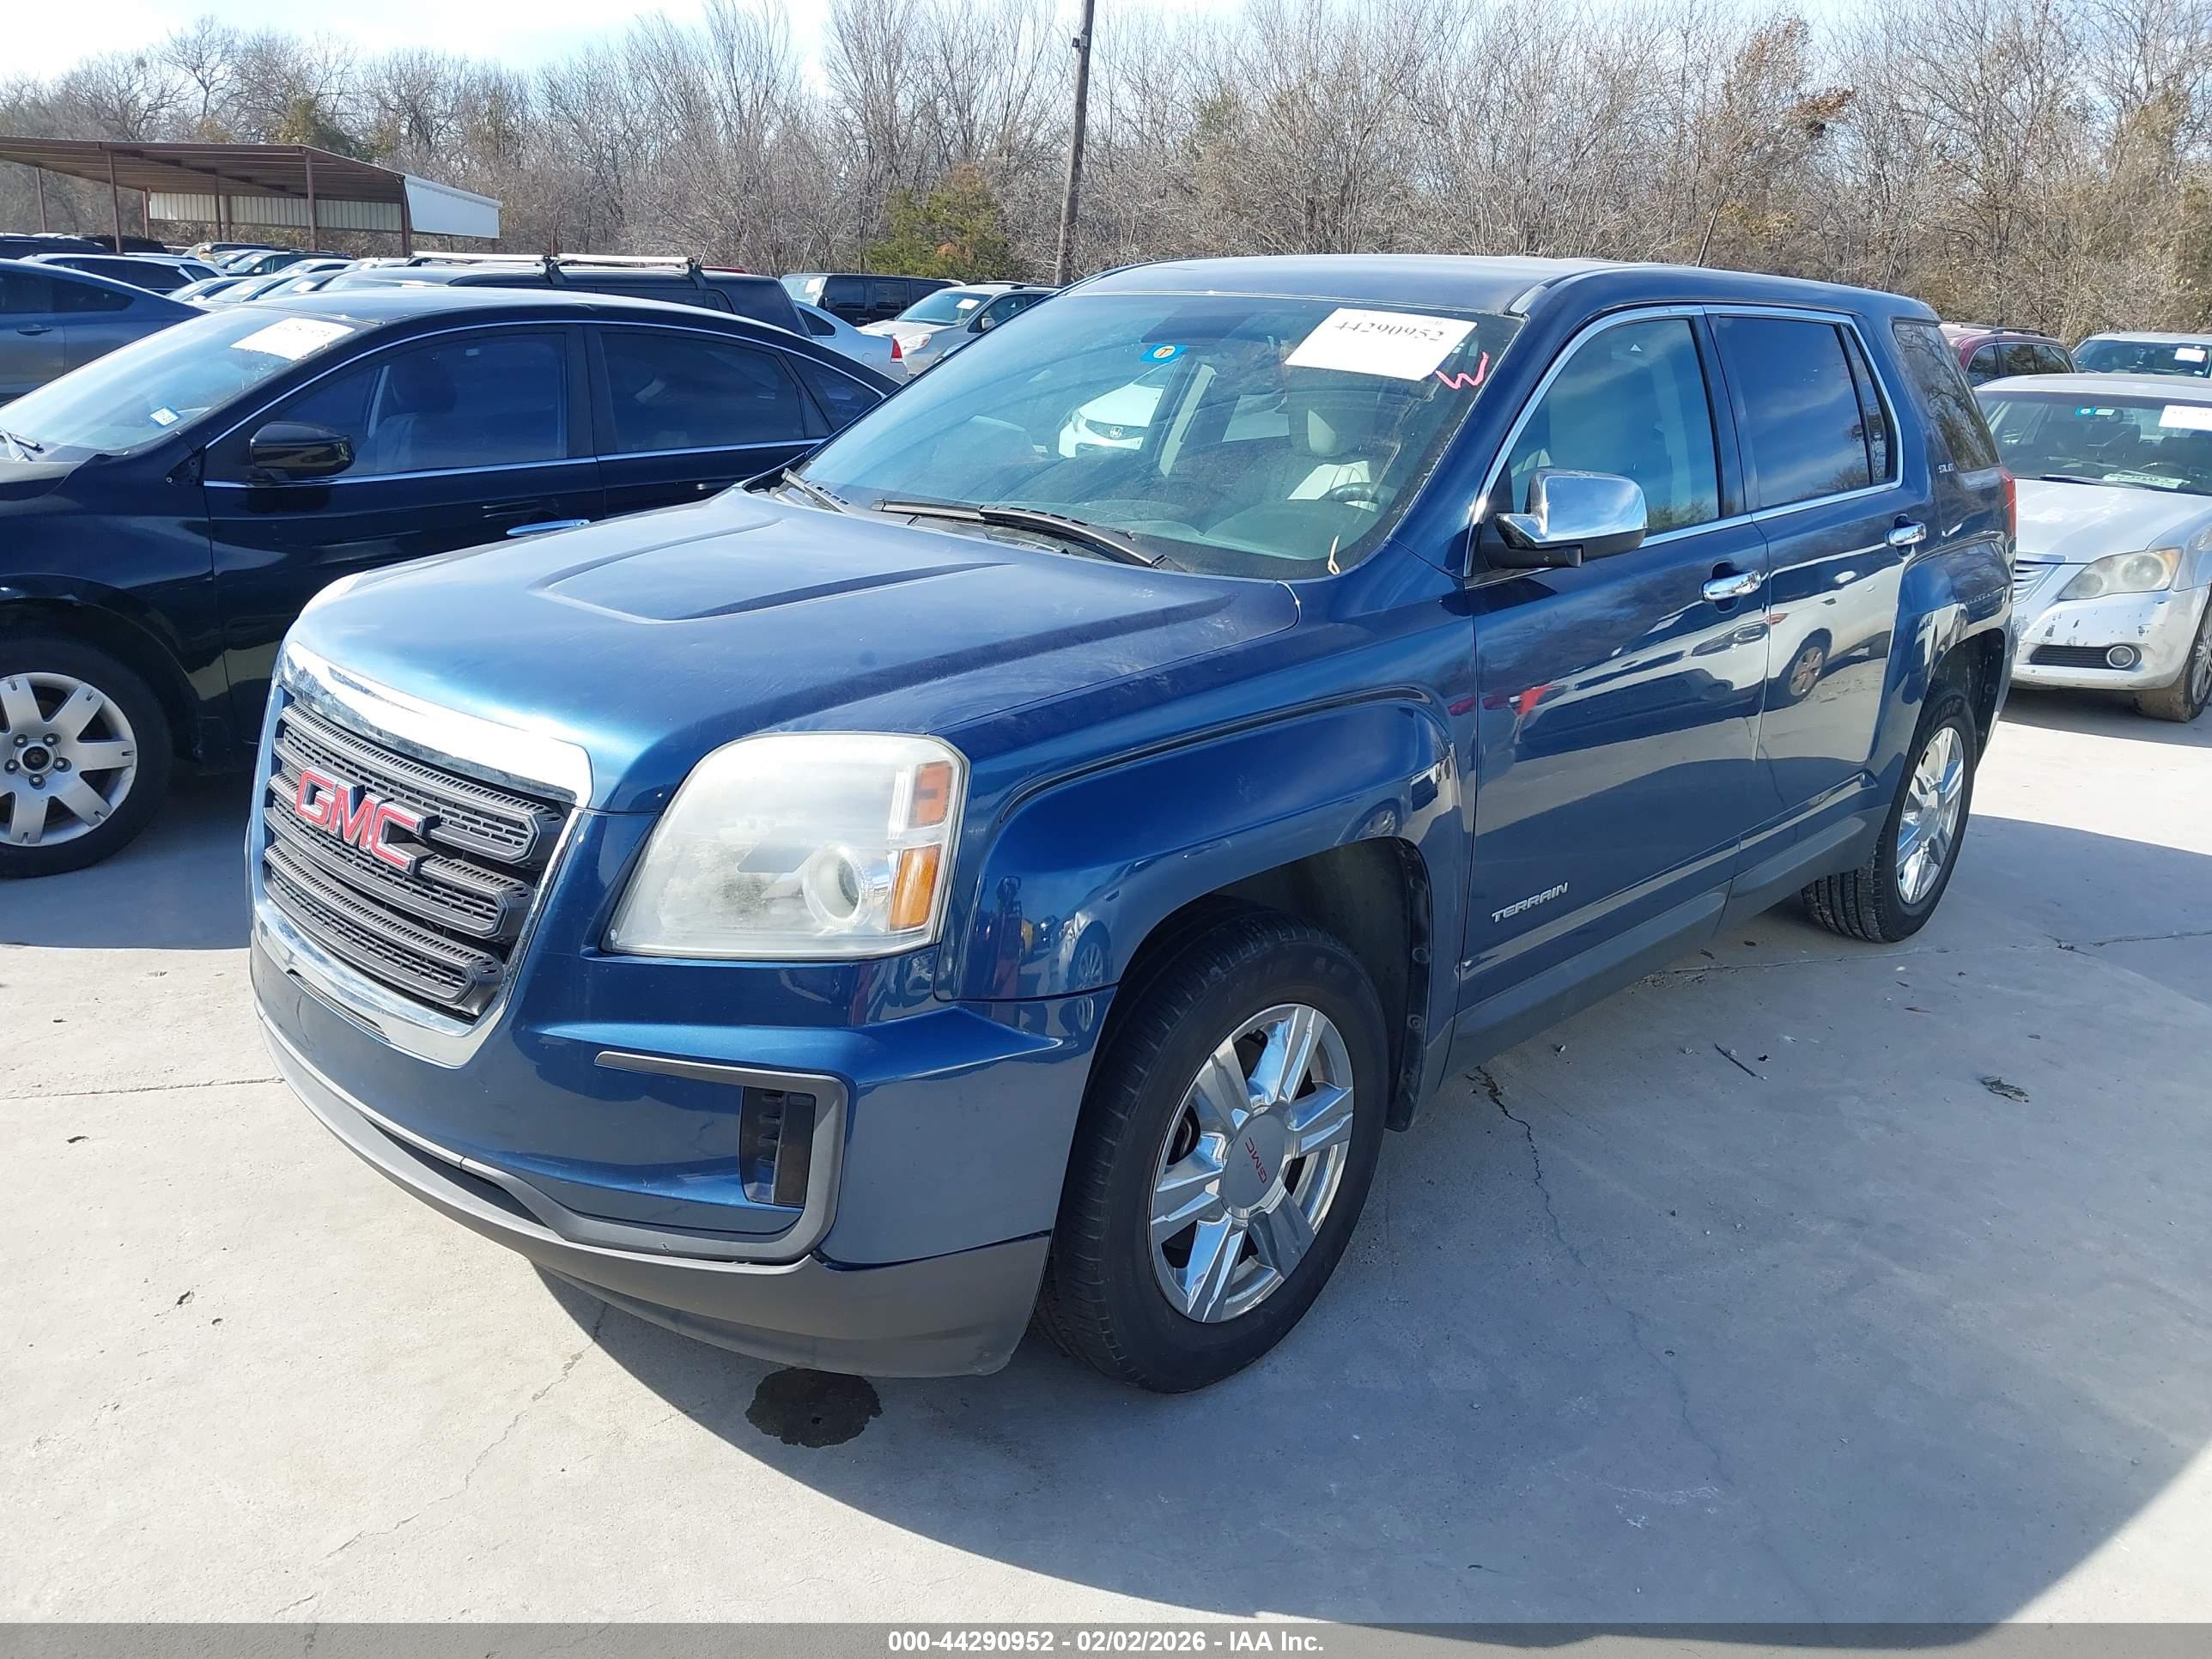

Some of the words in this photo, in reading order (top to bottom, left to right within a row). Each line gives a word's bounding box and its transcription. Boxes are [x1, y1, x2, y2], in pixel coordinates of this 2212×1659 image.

[1334, 321, 1445, 342] 44290952
[295, 765, 427, 875] GMC
[1491, 882, 1569, 923] TERRAIN
[1244, 1136, 1268, 1184] GMC
